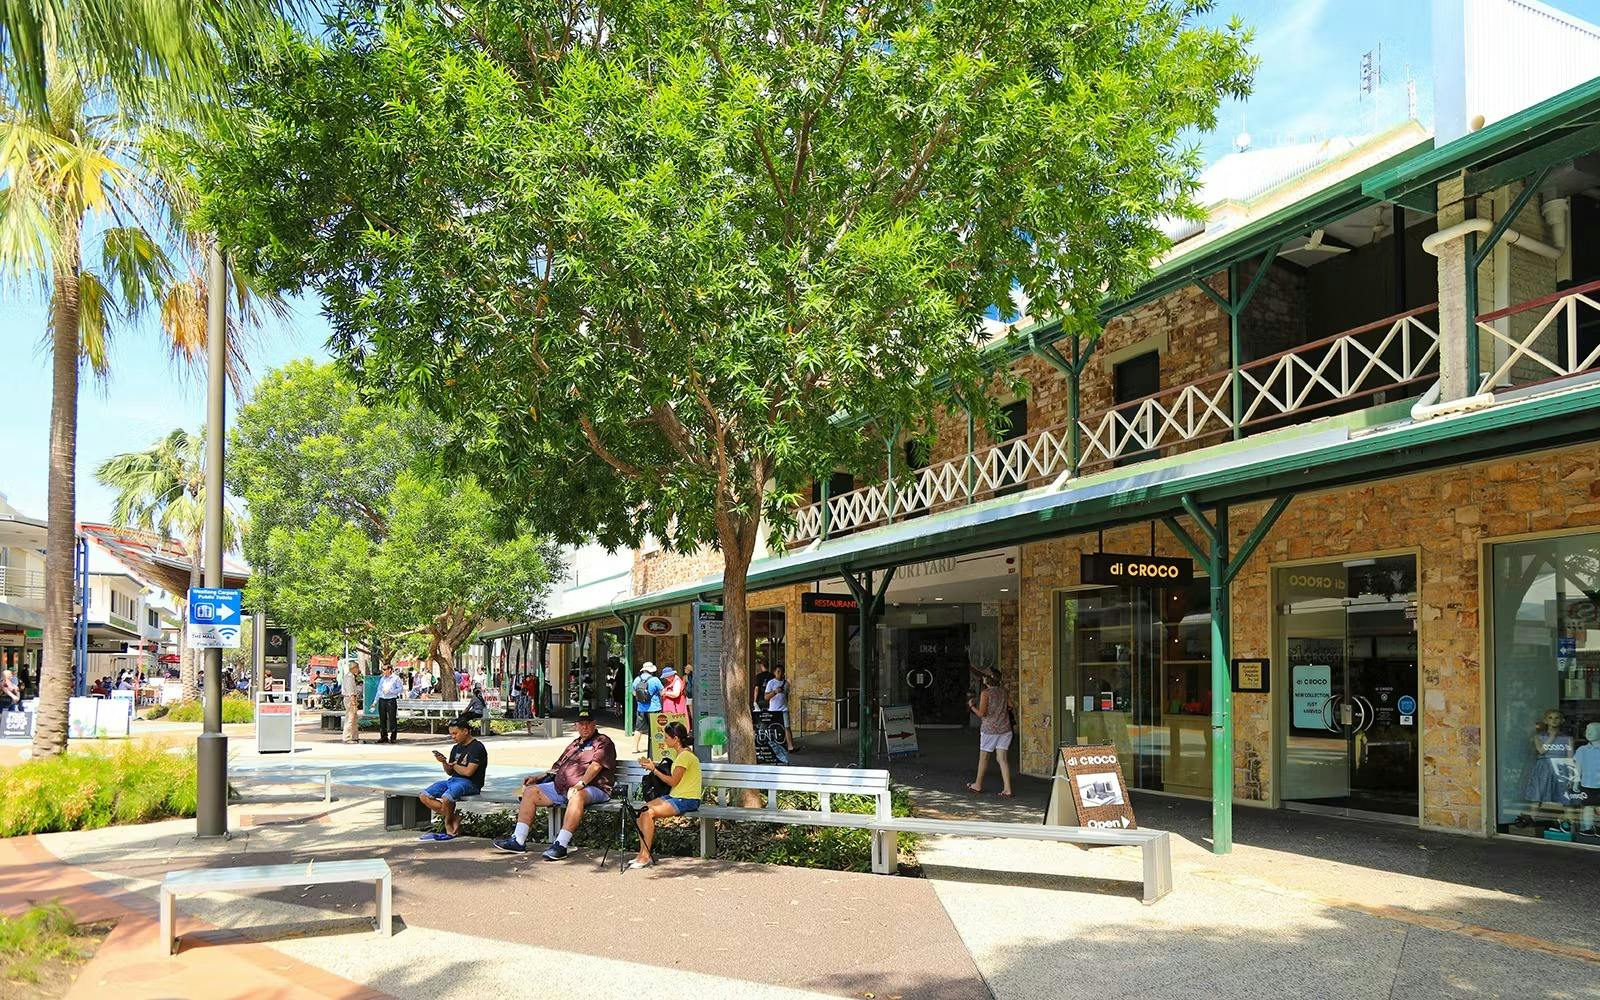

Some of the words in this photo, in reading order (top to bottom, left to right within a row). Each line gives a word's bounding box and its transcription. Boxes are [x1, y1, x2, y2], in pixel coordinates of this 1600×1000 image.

[1110, 563, 1123, 575] di
[1128, 563, 1179, 578] CROCO
[815, 599, 857, 608] RESTAURANT
[1067, 757, 1078, 766] di
[1080, 755, 1117, 766] CROCO
[1087, 819, 1121, 829] Open
